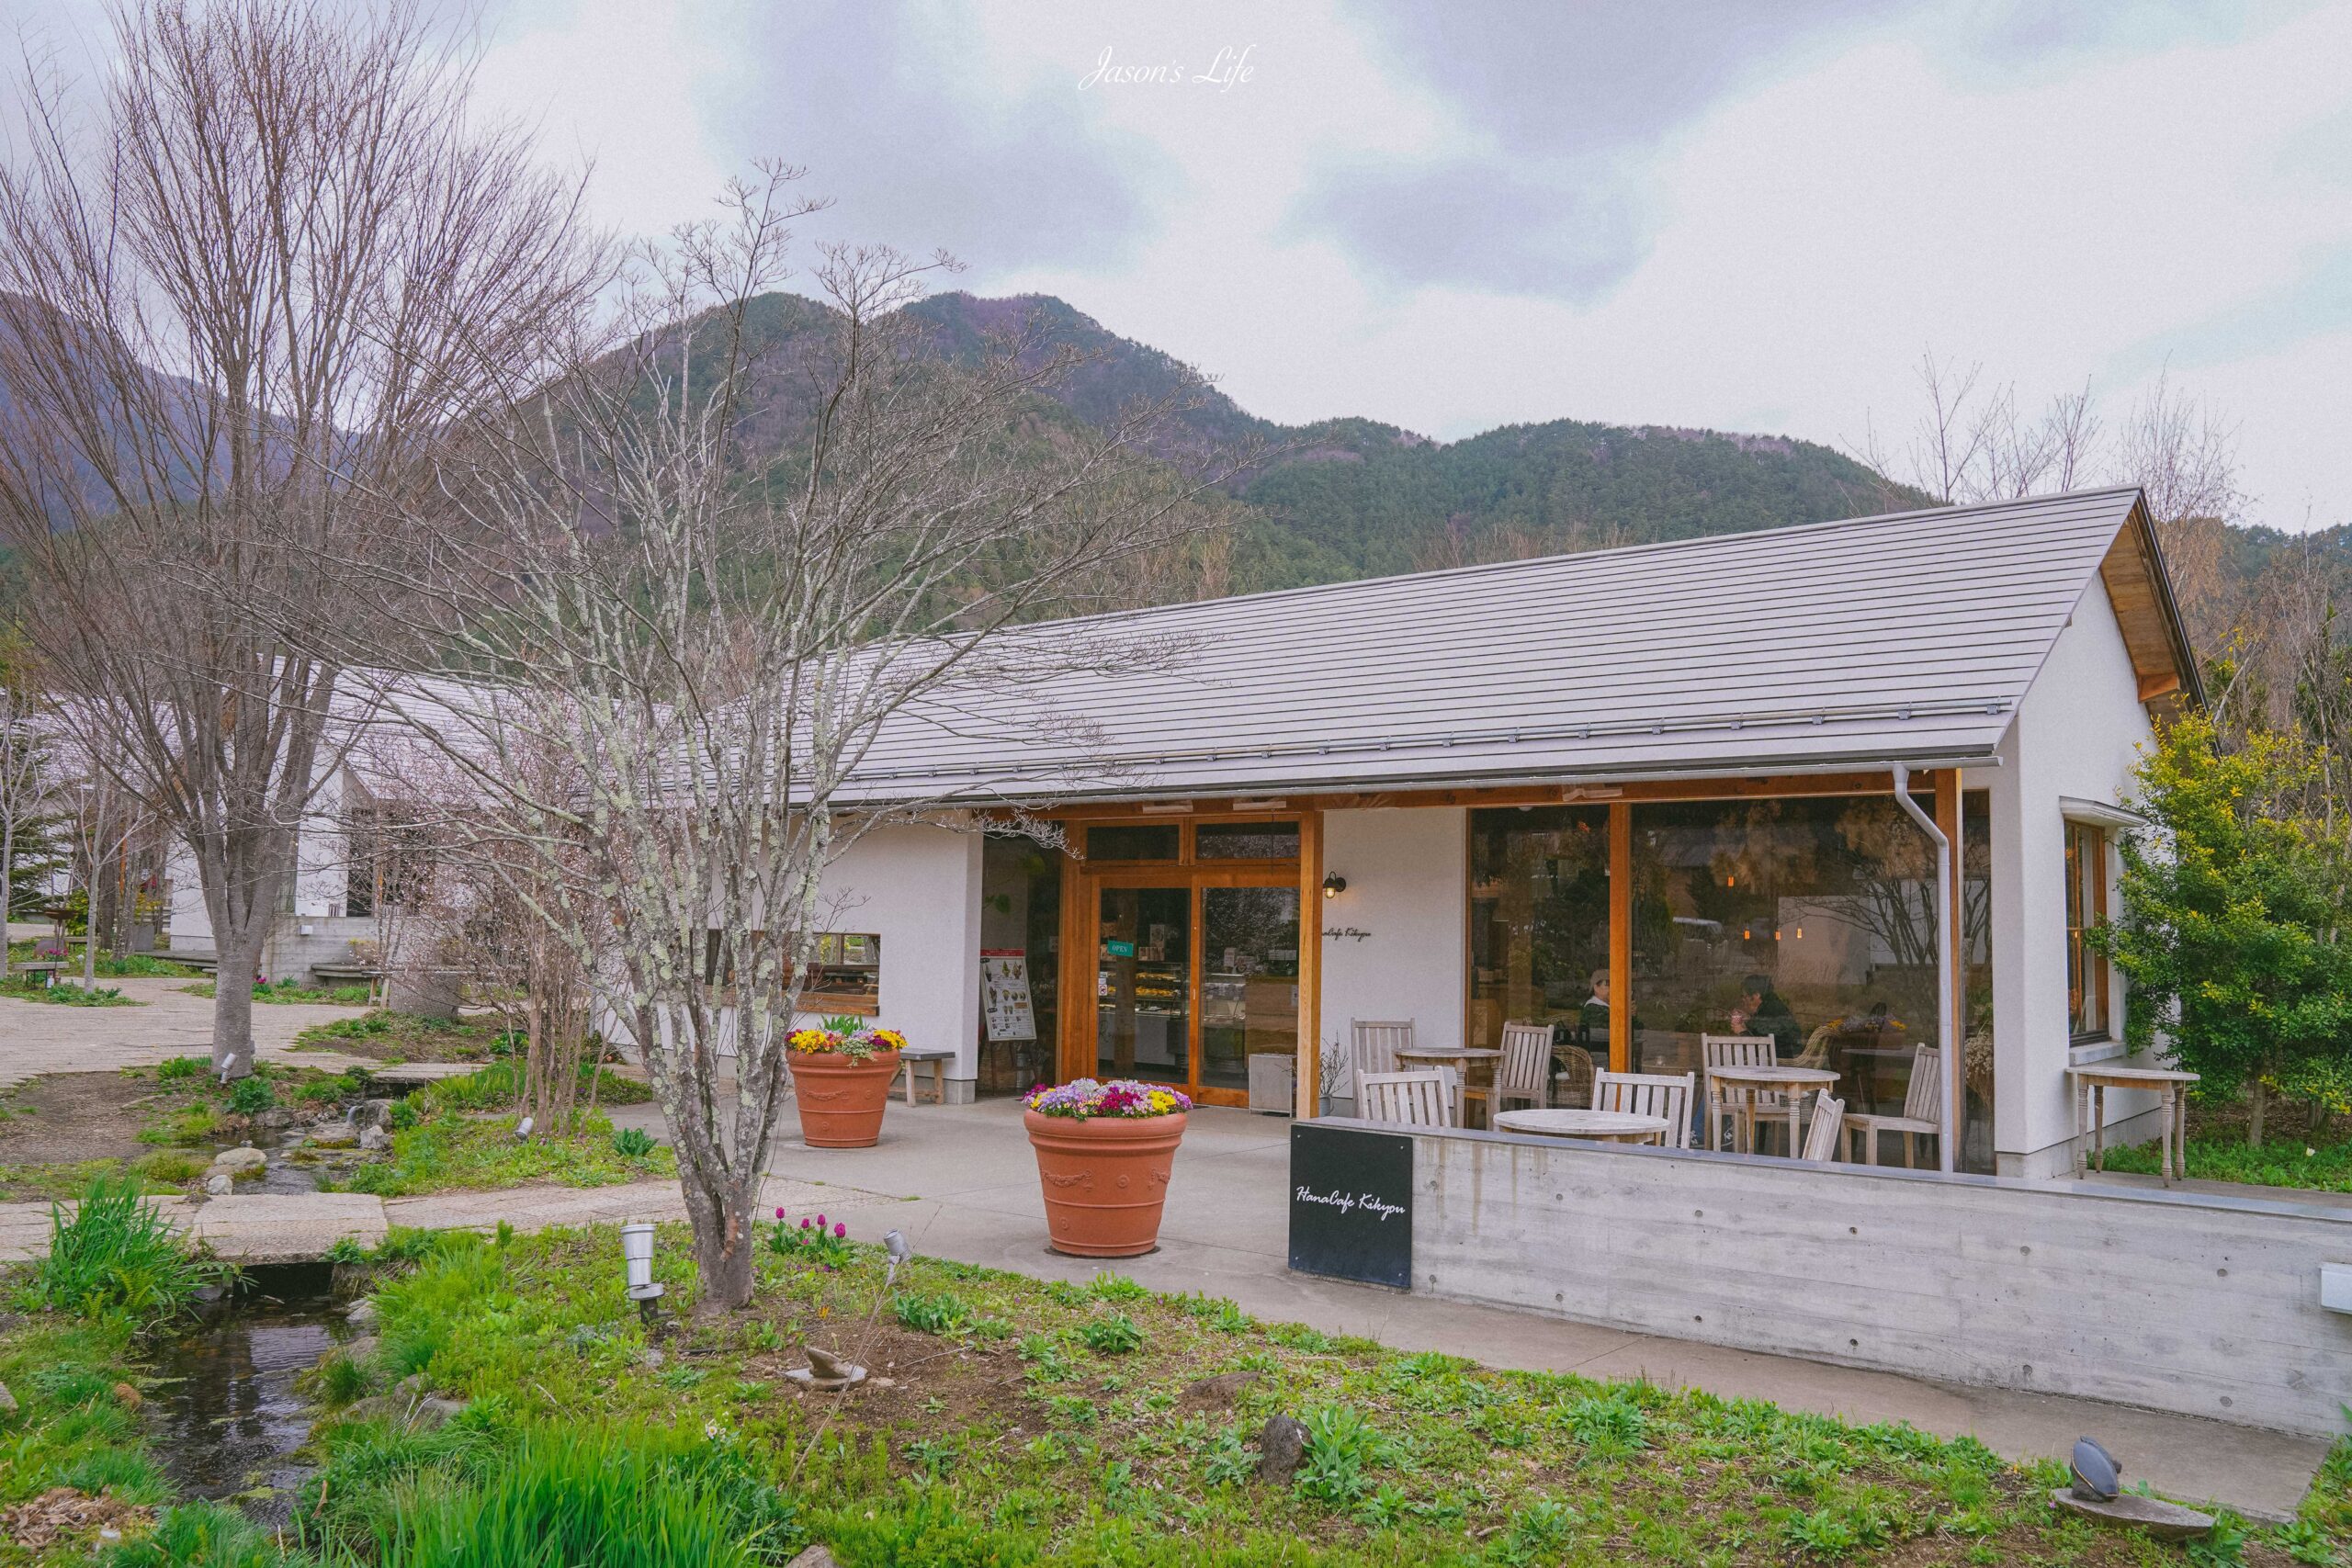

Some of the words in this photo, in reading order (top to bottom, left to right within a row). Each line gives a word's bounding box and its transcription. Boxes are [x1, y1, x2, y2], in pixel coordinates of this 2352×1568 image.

[1112, 944, 1128, 953] OPEN
[1296, 1186, 1355, 1213] HanaCafe
[1358, 1193, 1406, 1221] Kikyou
